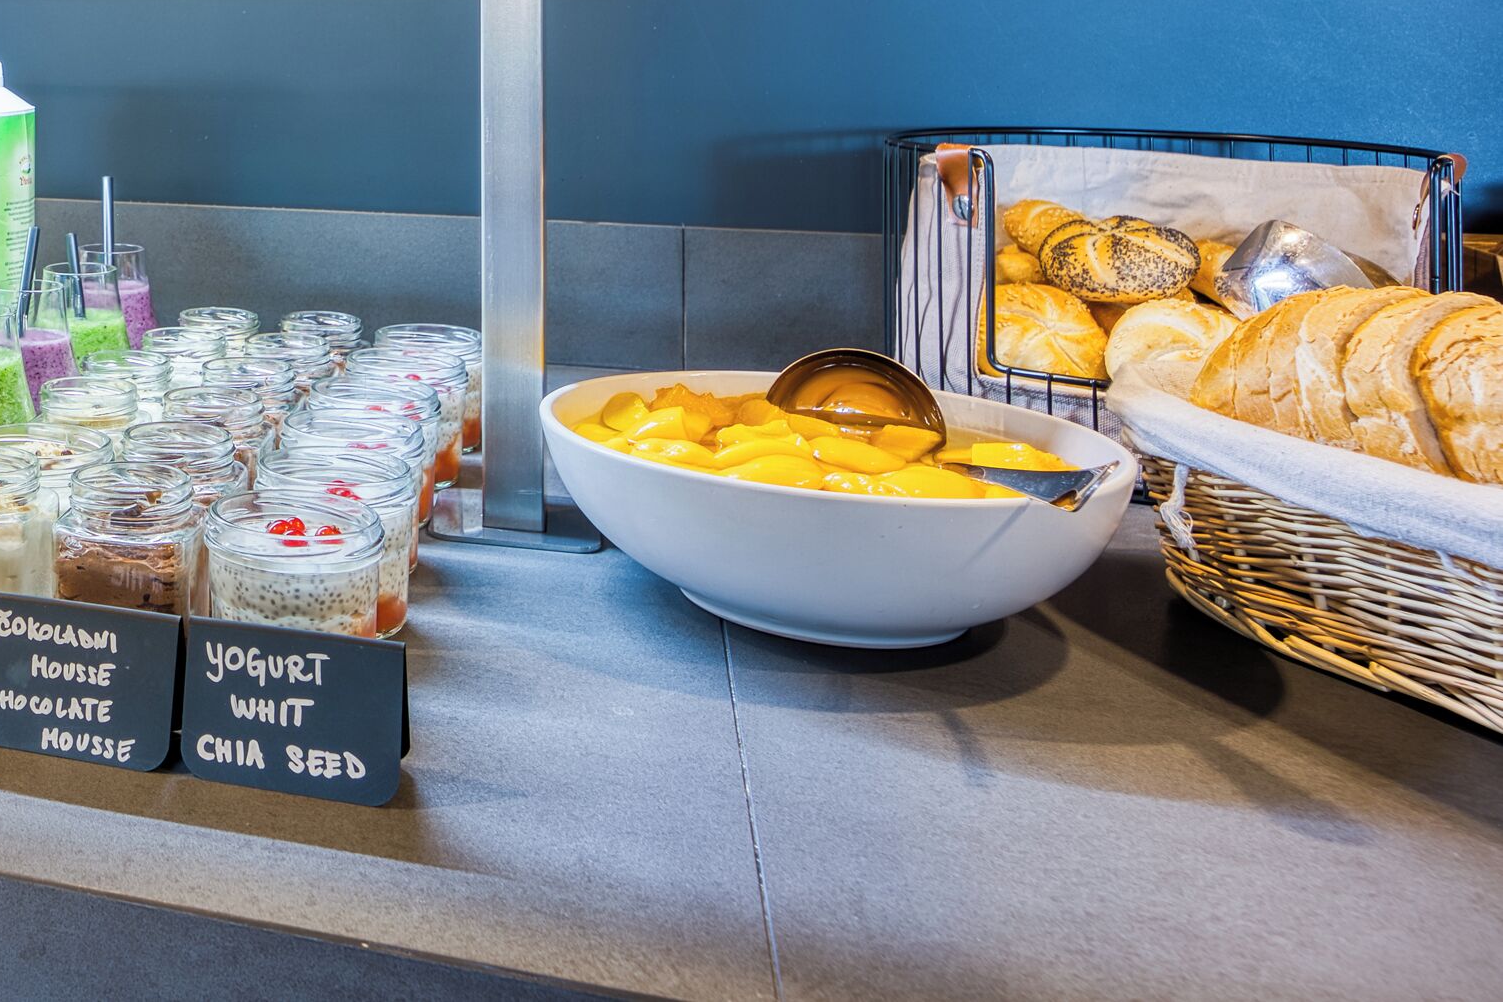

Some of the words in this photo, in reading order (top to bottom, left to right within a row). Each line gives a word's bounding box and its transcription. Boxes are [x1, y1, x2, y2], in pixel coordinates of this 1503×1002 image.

[30, 653, 117, 687] MOUSSE
[205, 640, 331, 687] YOGURT
[230, 693, 315, 728] WHIT
[41, 727, 136, 763] MOUSSE
[196, 733, 266, 770] CHIA
[285, 744, 366, 780] SEED
